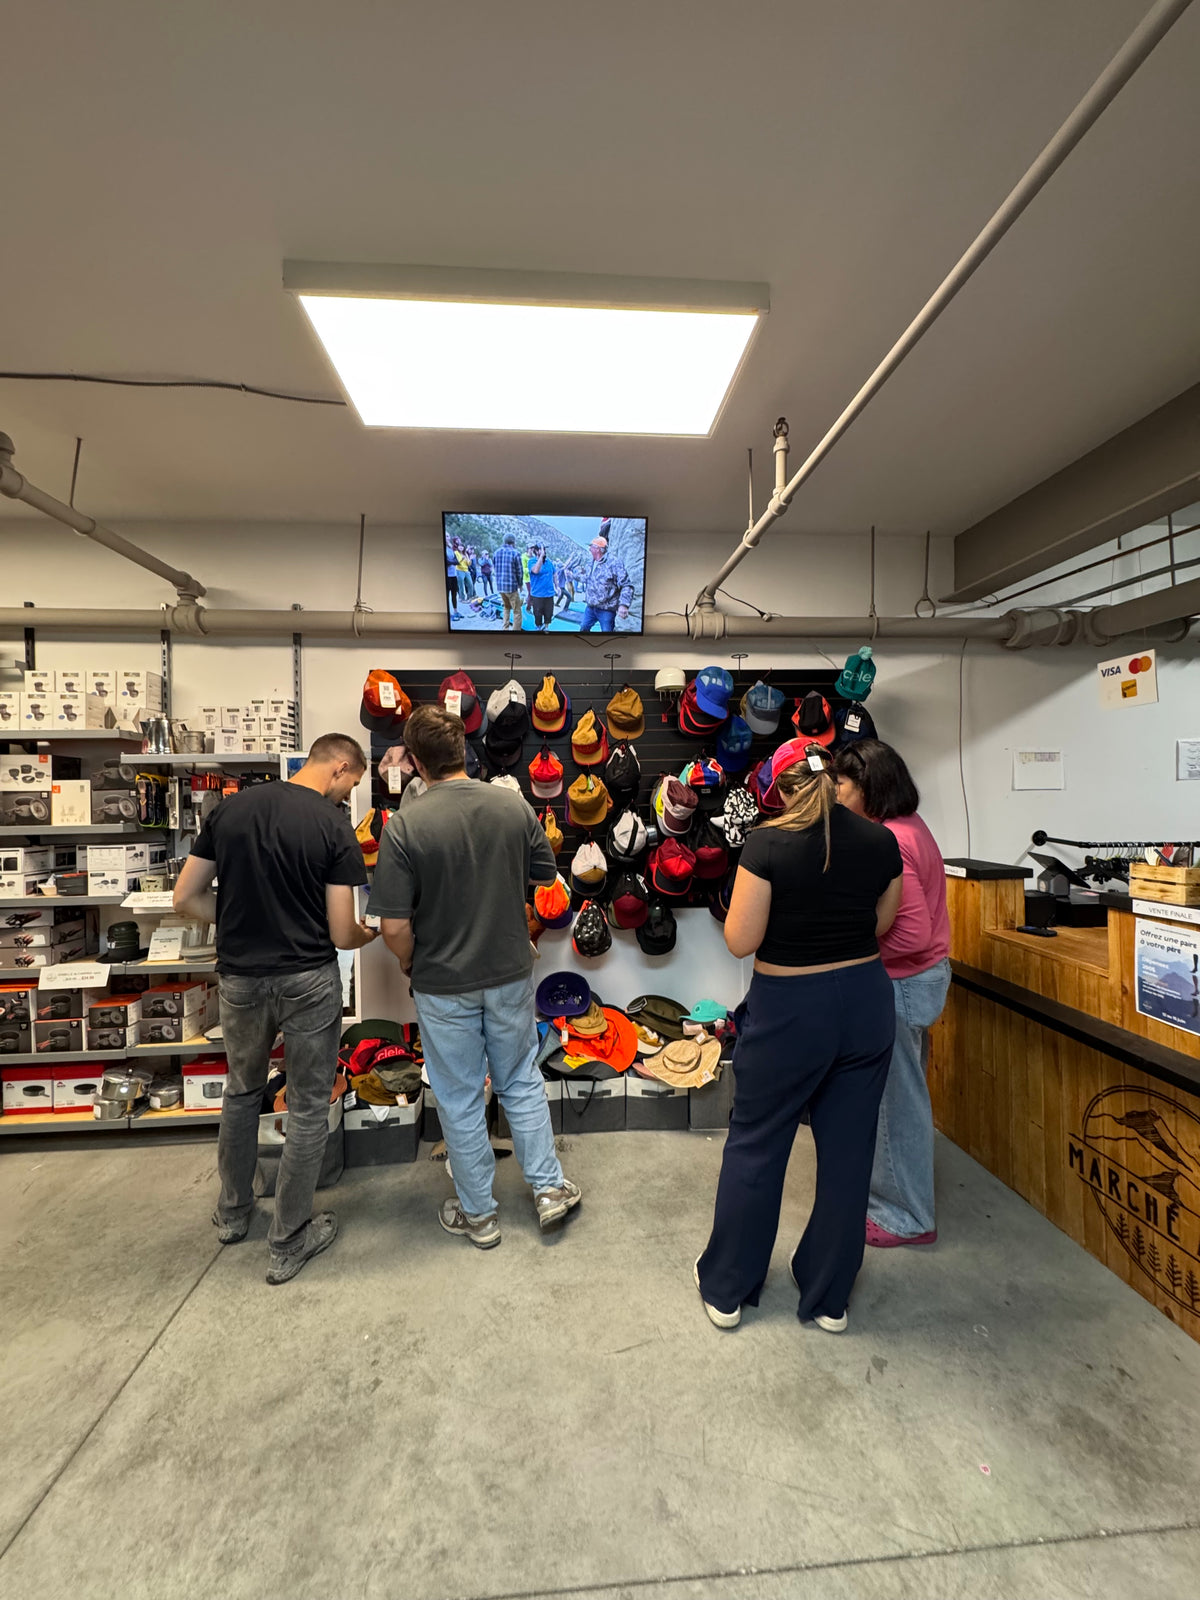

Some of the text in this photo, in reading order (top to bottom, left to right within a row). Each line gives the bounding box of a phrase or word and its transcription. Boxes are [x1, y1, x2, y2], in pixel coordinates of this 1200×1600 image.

[1101, 665, 1121, 678] VISA
[1149, 907, 1192, 920] VENTE FINALE
[1140, 929, 1162, 940] Offrez
[1163, 936, 1179, 944] une
[1180, 940, 1197, 949] paire
[1146, 941, 1165, 950] votre
